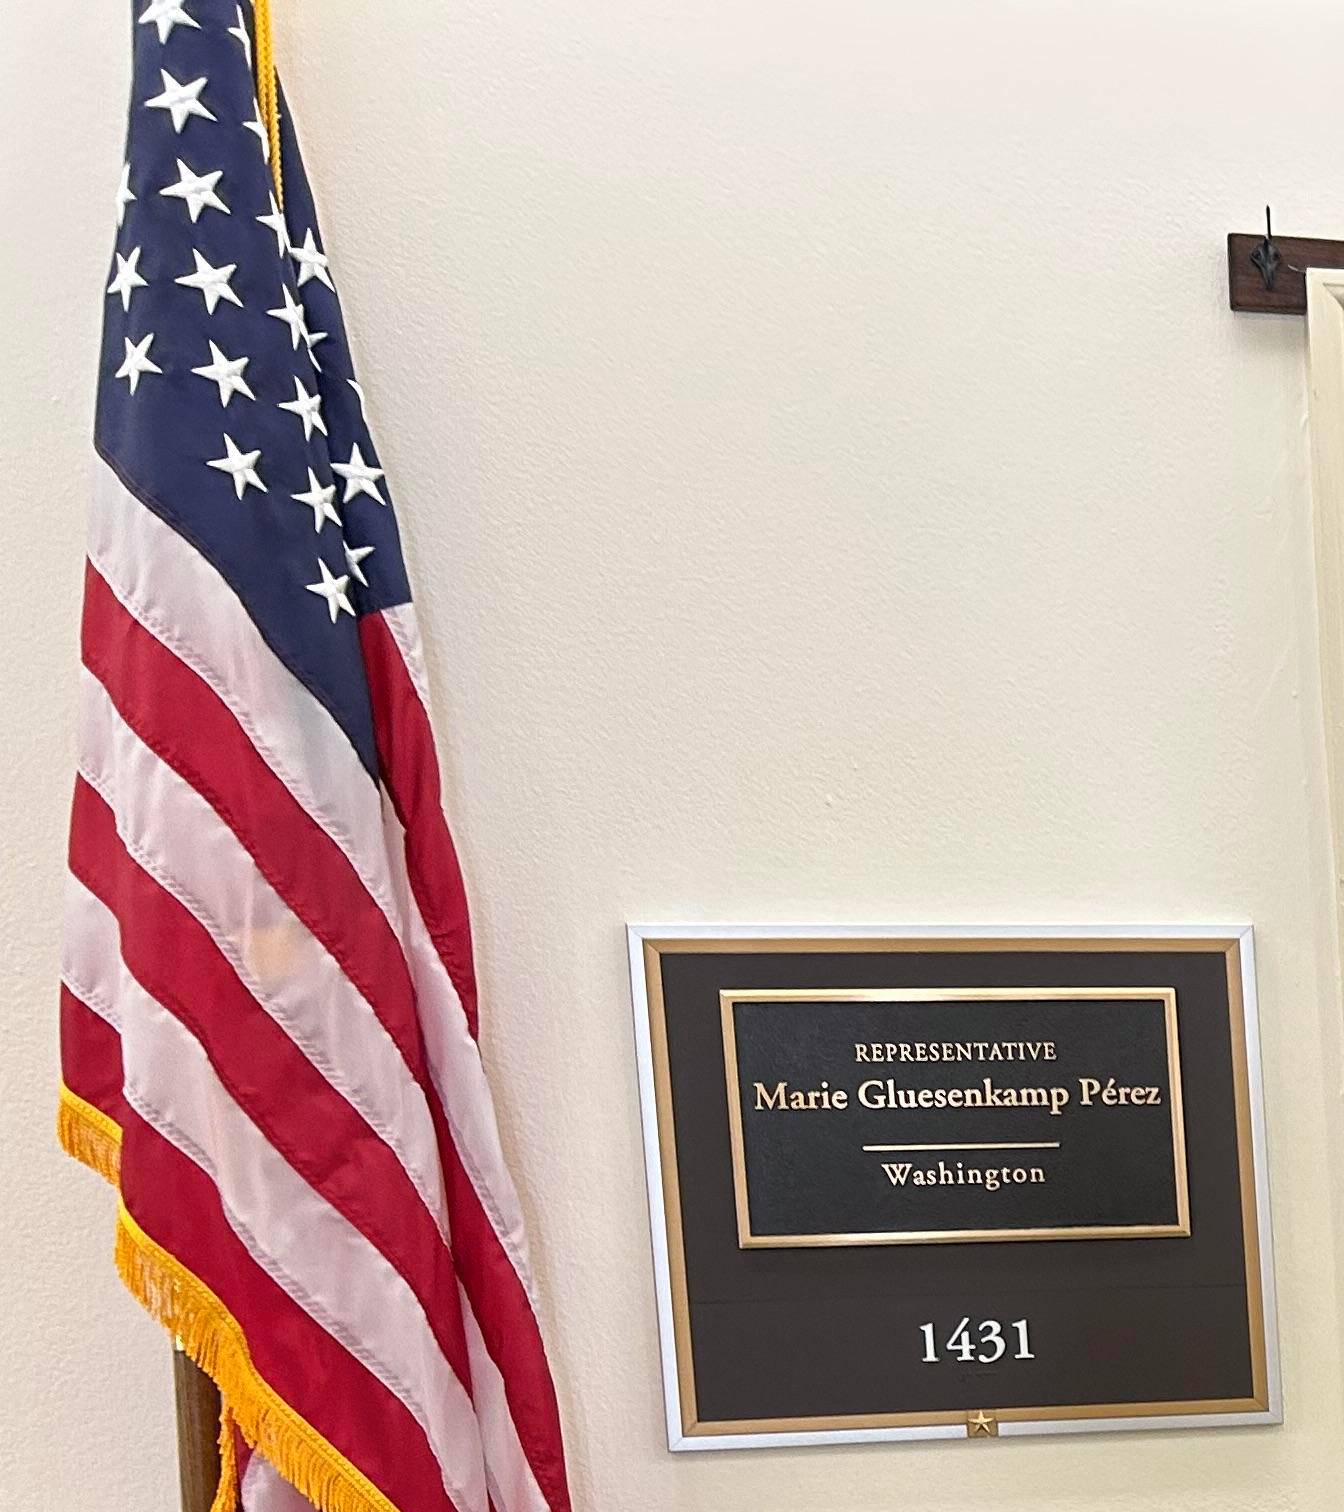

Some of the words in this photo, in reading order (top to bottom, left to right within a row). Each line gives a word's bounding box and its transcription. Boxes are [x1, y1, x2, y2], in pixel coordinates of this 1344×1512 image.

[854, 1041, 1057, 1063] REPRESENTATIVE
[752, 1080, 848, 1111] Marie
[857, 1077, 1070, 1115] Gluesenkamp
[1078, 1076, 1162, 1106] Pérez
[880, 1160, 1046, 1191] Washington
[919, 1317, 1035, 1364] 1431
